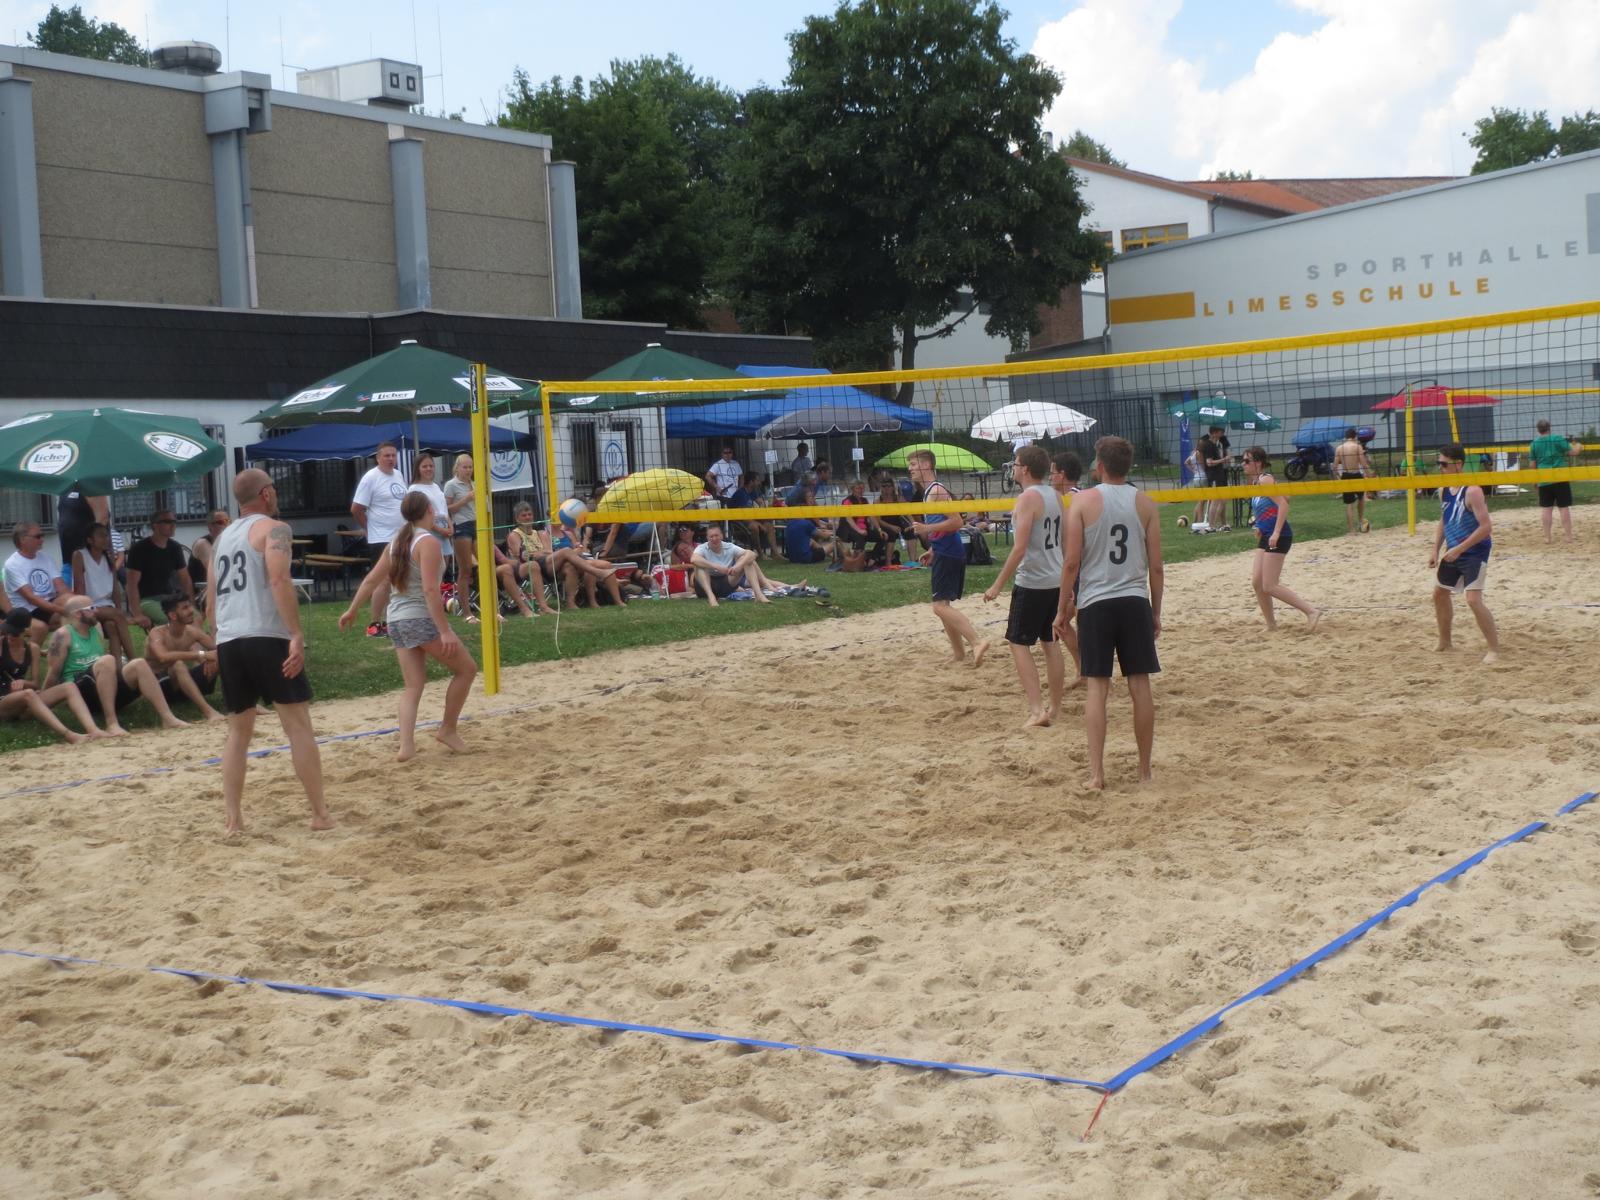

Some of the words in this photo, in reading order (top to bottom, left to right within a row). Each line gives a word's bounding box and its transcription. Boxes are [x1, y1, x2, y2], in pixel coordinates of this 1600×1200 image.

[1306, 241, 1578, 280] SPORTHALLE
[1203, 278, 1490, 317] LIMESSCHULE
[377, 392, 409, 400] Licher
[33, 453, 67, 463] Licher
[112, 476, 139, 490] Licher
[1044, 515, 1061, 550] 21
[1109, 523, 1129, 565] 3
[216, 550, 248, 596] 23
